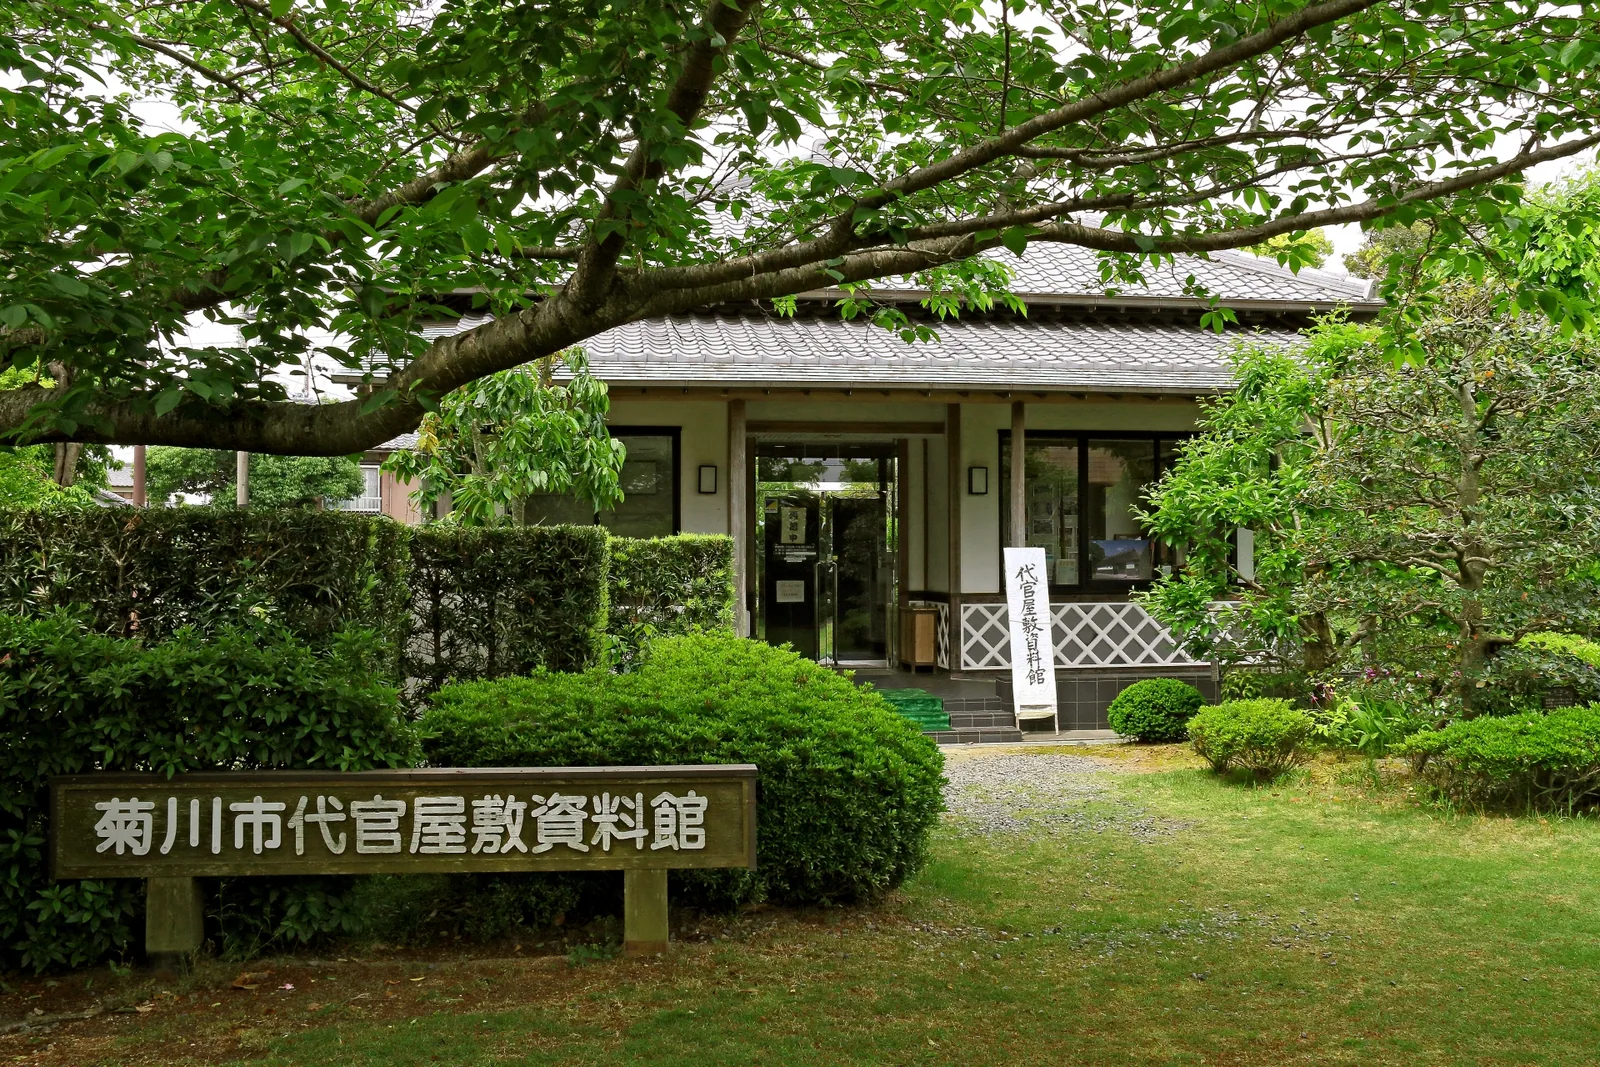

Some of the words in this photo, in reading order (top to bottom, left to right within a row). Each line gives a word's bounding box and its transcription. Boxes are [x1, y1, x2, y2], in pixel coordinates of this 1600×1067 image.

[1015, 563, 1046, 686] 代官屋敷資料館
[94, 790, 708, 856] 菊川市代官屋敷資料館
